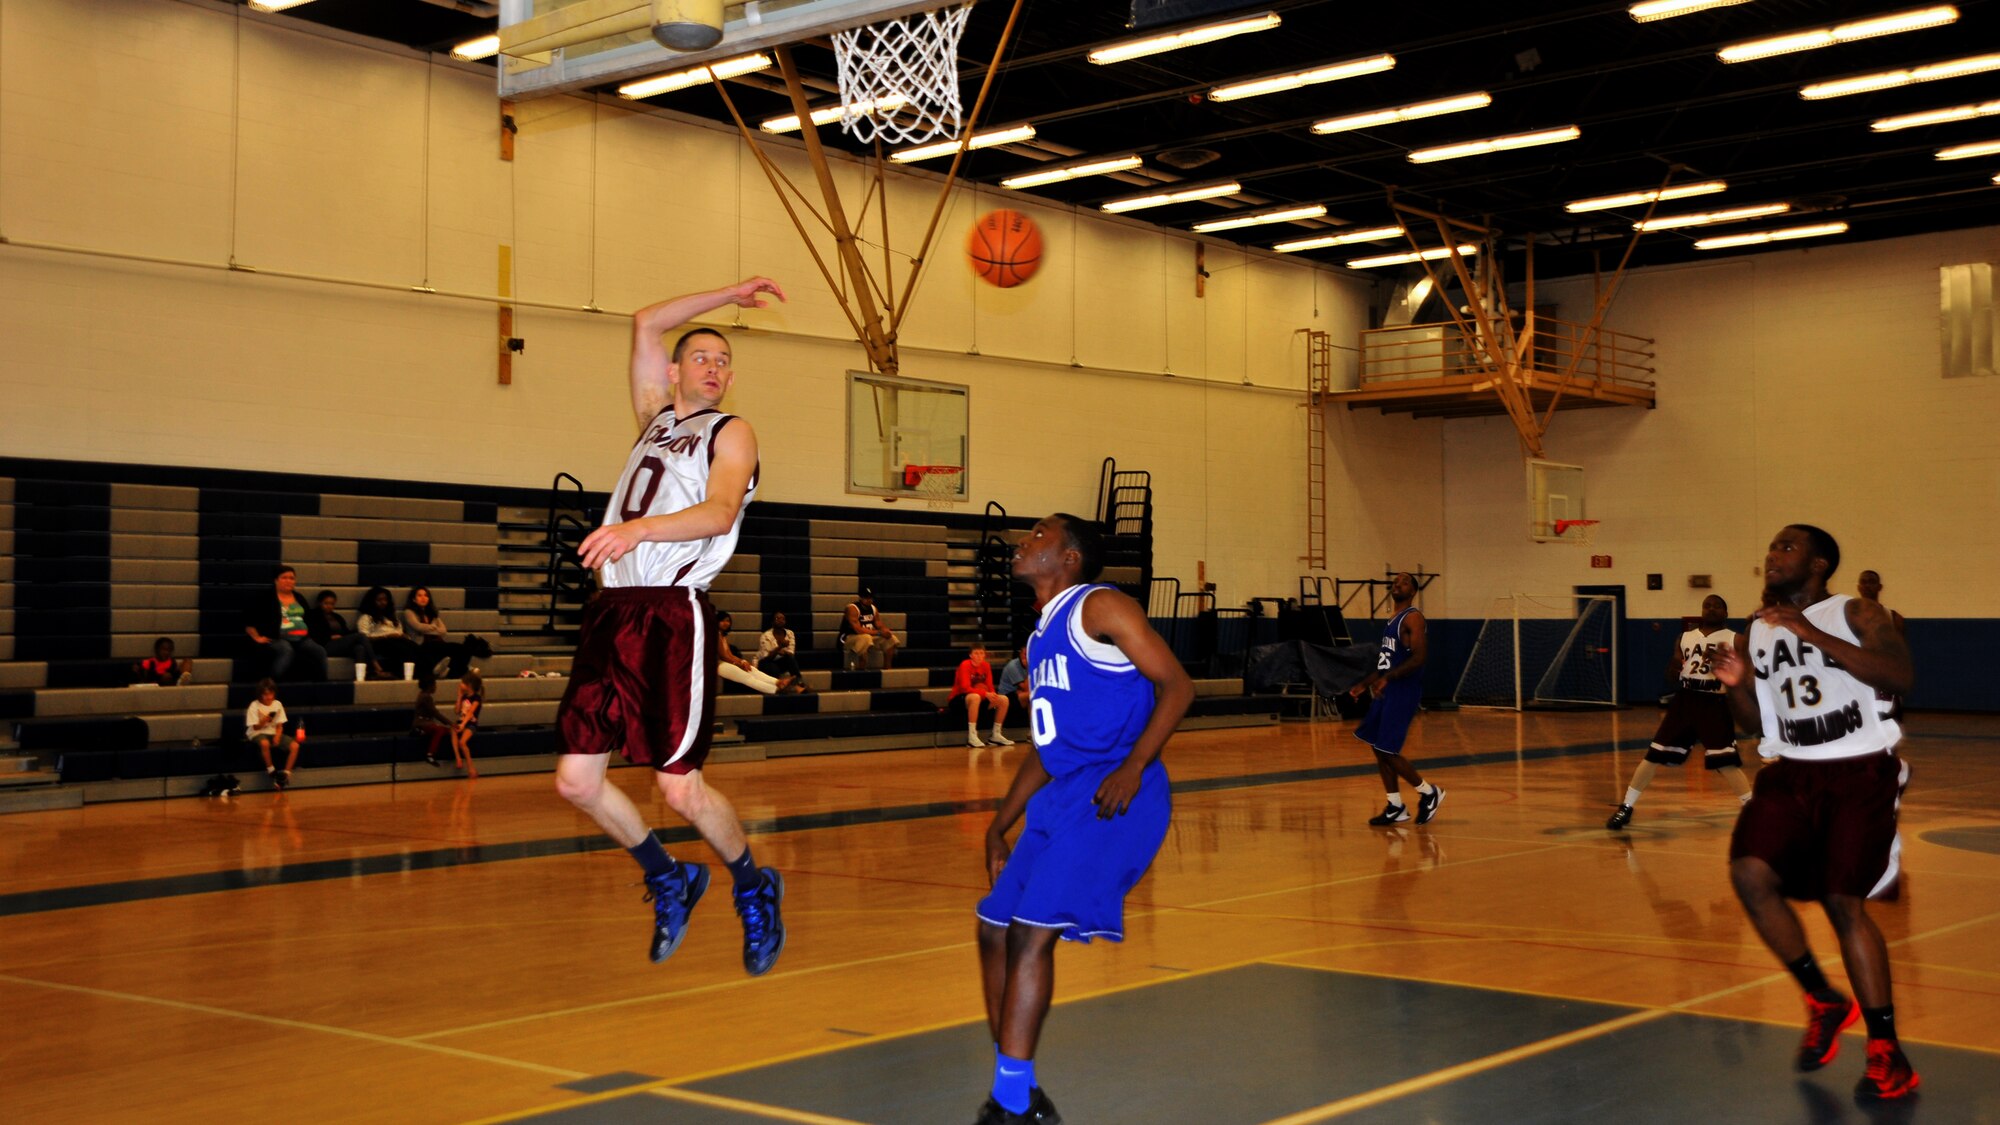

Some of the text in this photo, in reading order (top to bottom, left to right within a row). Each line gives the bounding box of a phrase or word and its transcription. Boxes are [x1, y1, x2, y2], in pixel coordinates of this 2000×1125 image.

[620, 455, 665, 522] 0
[1377, 651, 1391, 670] 25
[1689, 660, 1710, 675] 25
[1755, 638, 1845, 680] CAF
[1780, 674, 1822, 709] 13
